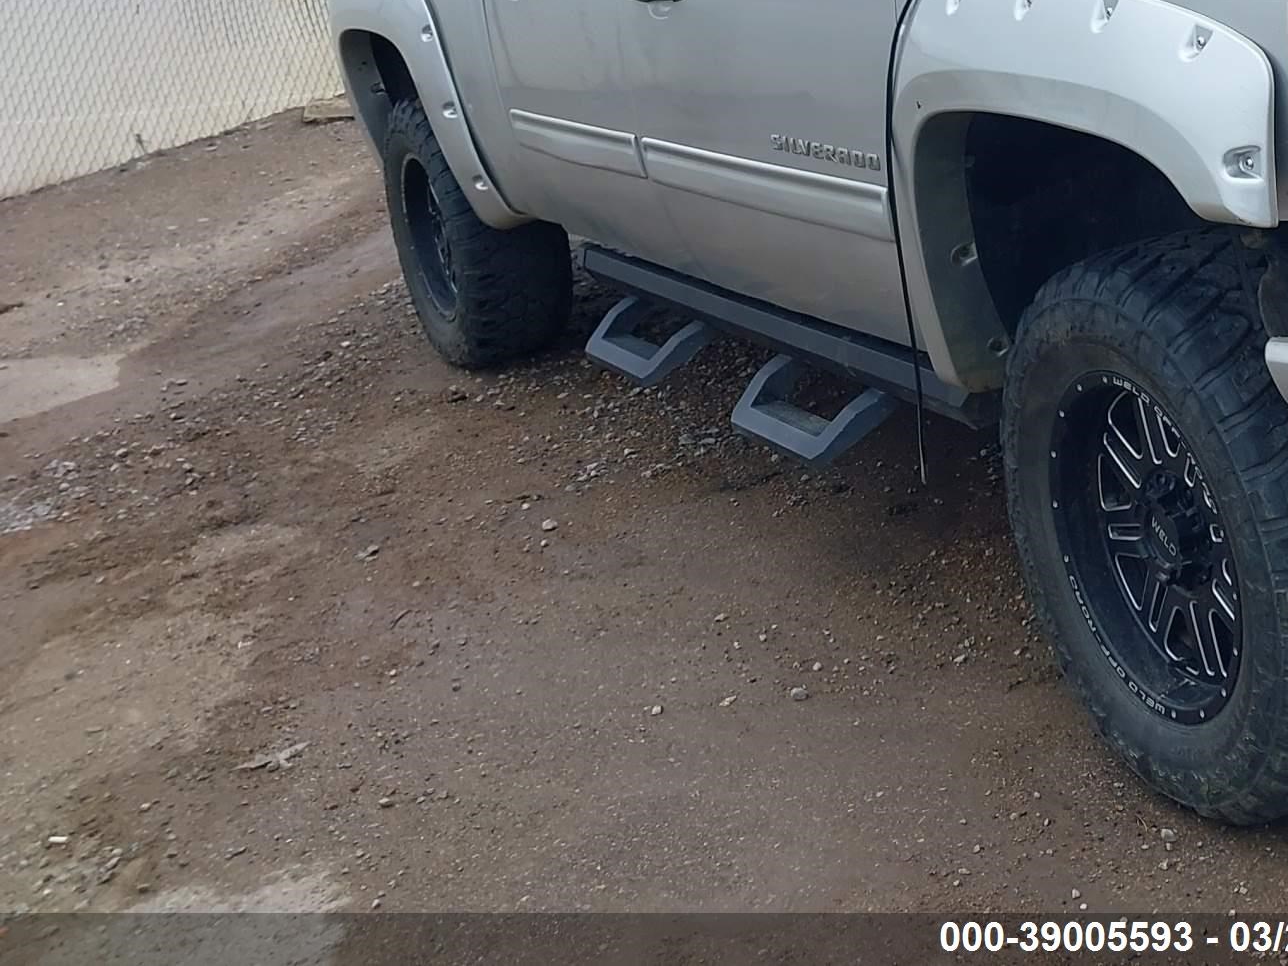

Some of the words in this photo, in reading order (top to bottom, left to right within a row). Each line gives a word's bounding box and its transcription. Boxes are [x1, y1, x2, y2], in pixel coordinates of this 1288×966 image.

[770, 134, 881, 171] SILVERADO
[1113, 376, 1150, 404] WELD
[1151, 516, 1177, 556] WELD
[1128, 680, 1166, 715] WELD
